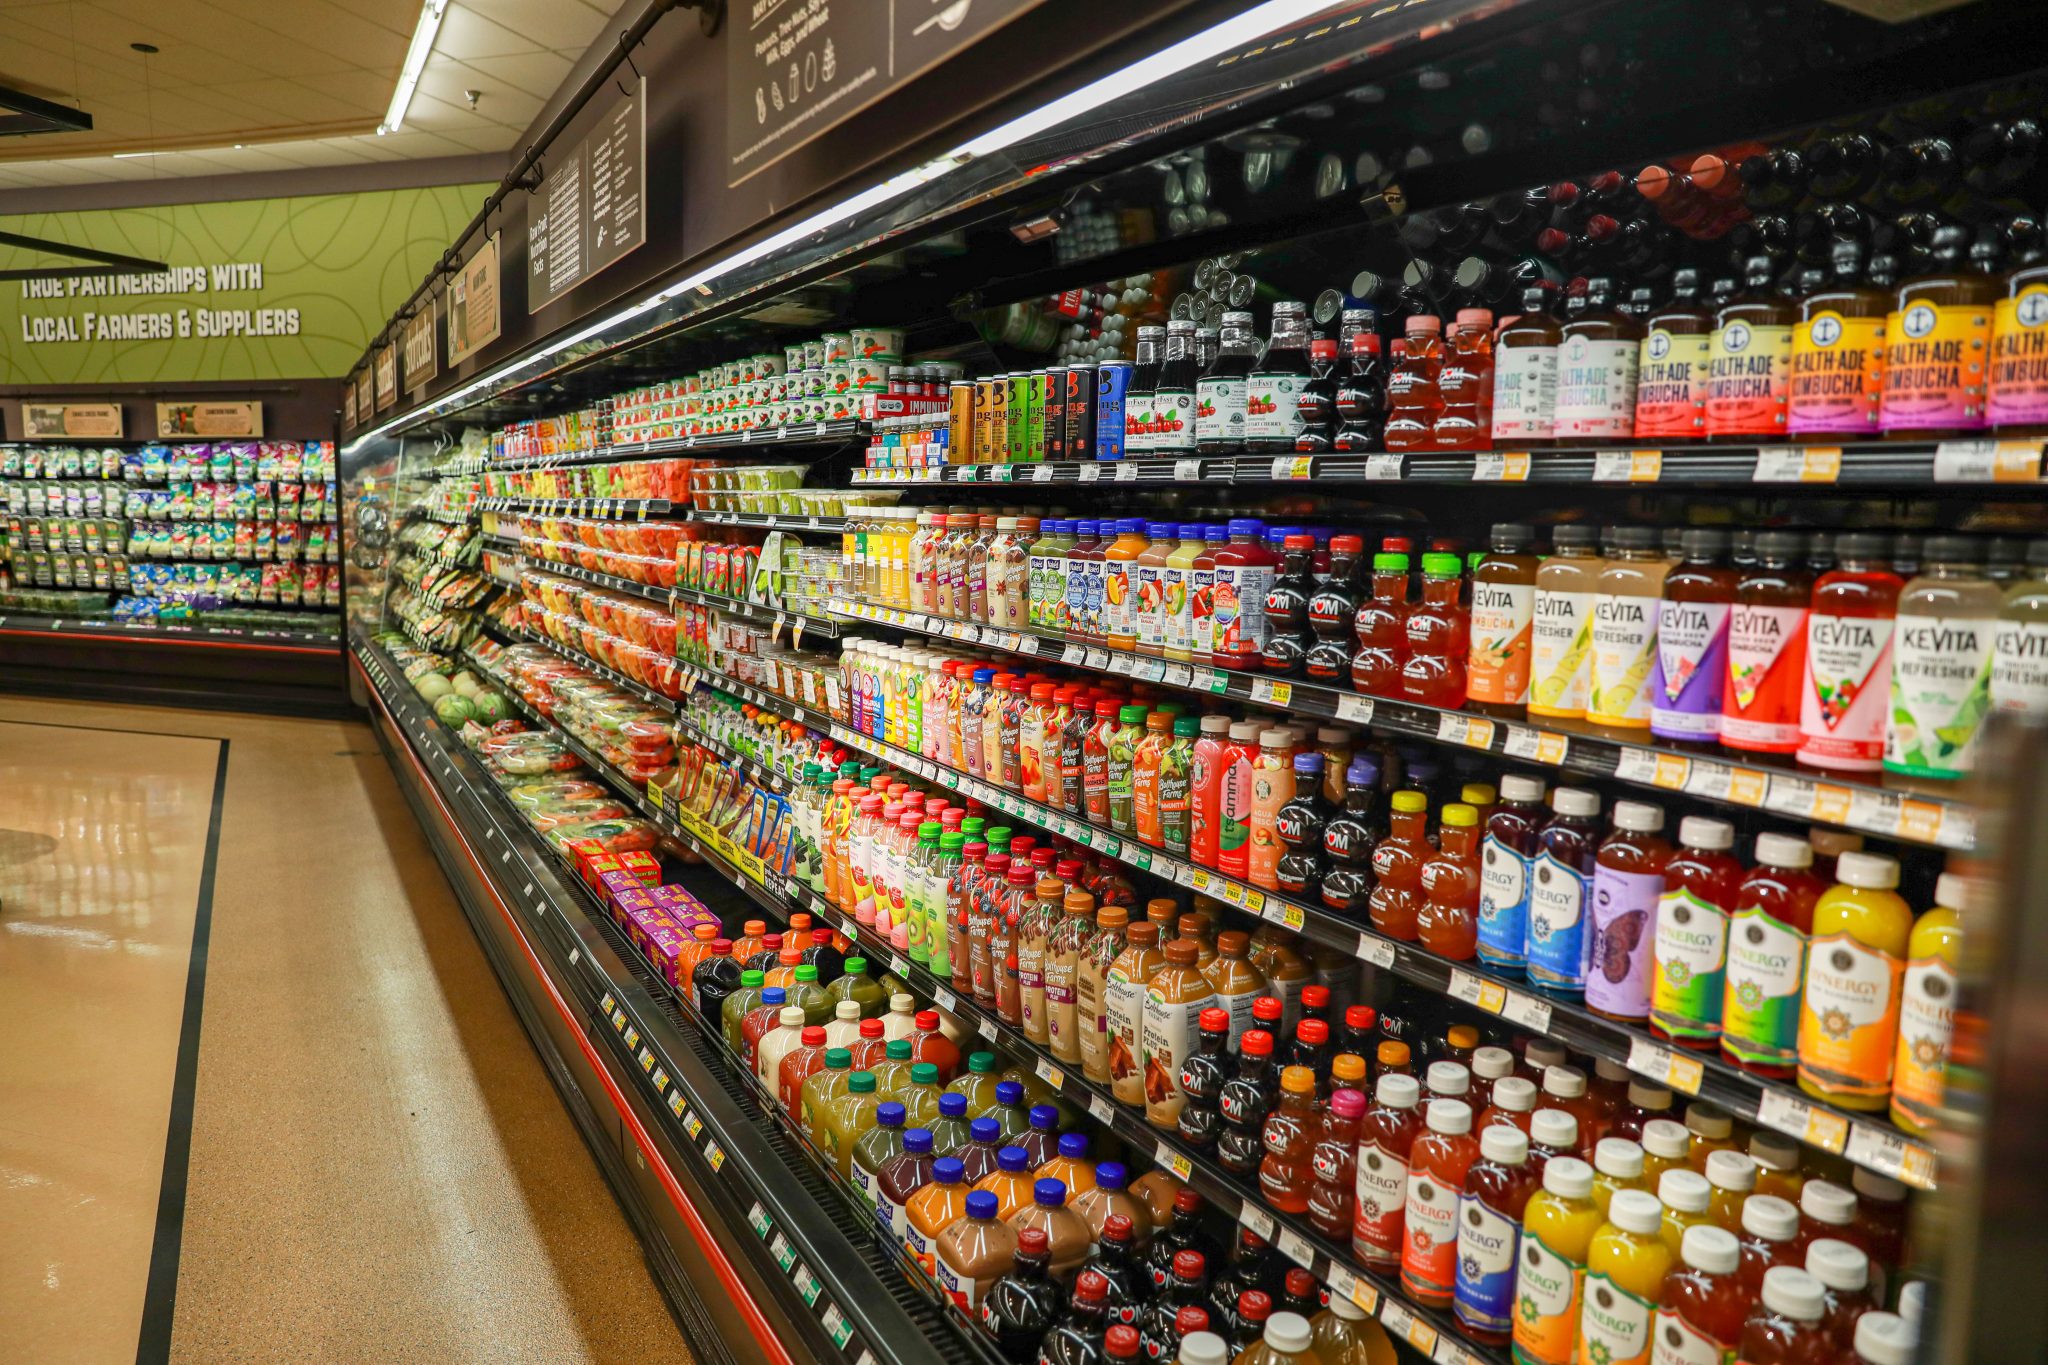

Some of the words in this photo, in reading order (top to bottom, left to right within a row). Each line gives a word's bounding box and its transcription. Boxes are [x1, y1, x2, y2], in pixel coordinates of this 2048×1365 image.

[538, 213, 548, 235] Fruit
[531, 236, 548, 261] Nutrition
[533, 257, 544, 277] Facts
[22, 277, 65, 299] TRUE
[69, 266, 208, 298] PARTNERSHIPS
[211, 264, 263, 291] WITH
[177, 308, 192, 338] &
[910, 400, 950, 414] IMMUNITY
[1264, 592, 1289, 610] POM
[1309, 597, 1339, 616] POM
[1407, 616, 1431, 632] POM
[1903, 627, 1978, 652] KEVITA
[1163, 790, 1183, 800] Farms
[1224, 764, 1238, 833] tsamma
[1252, 810, 1273, 818] AGUA
[1195, 876, 1206, 885] FREE
[1226, 889, 1239, 899] FREE
[1046, 972, 1066, 985] Farms
[1107, 978, 1135, 999] Bolthouse
[1046, 985, 1067, 997] PROTEIN
[1106, 1005, 1132, 1025] Protein
[1144, 998, 1171, 1020] Bolthouse
[1106, 1015, 1121, 1028] PLUS
[1143, 1025, 1169, 1047] Protein
[1143, 1036, 1158, 1050] PLUS
[1264, 1127, 1287, 1147] POM
[1313, 1153, 1338, 1176] POM
[907, 1227, 924, 1252] Naked
[938, 1265, 957, 1291] Naked
